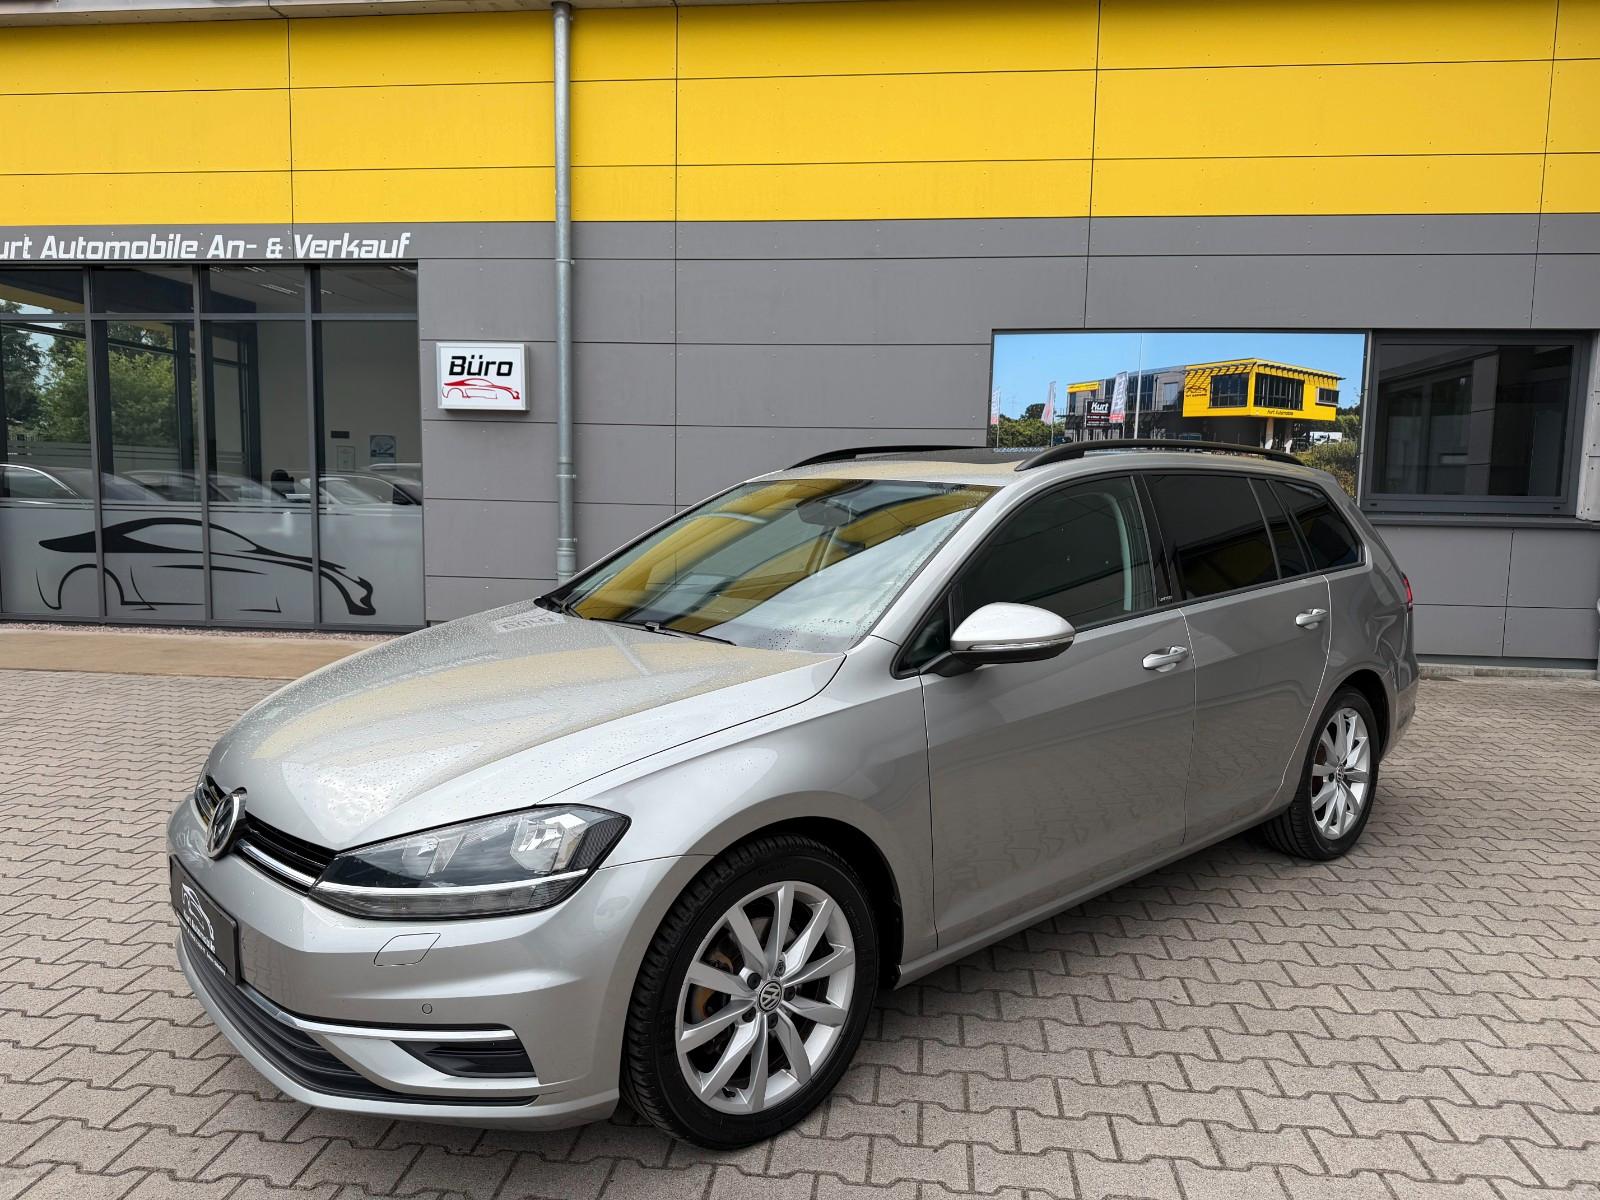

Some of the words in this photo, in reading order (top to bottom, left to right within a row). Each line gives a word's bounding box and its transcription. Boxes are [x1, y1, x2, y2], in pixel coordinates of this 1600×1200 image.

[40, 233, 198, 259] Automobile
[206, 234, 257, 259] An-
[265, 237, 283, 259] &
[294, 232, 411, 259] Verkauf
[448, 354, 514, 377] Büro
